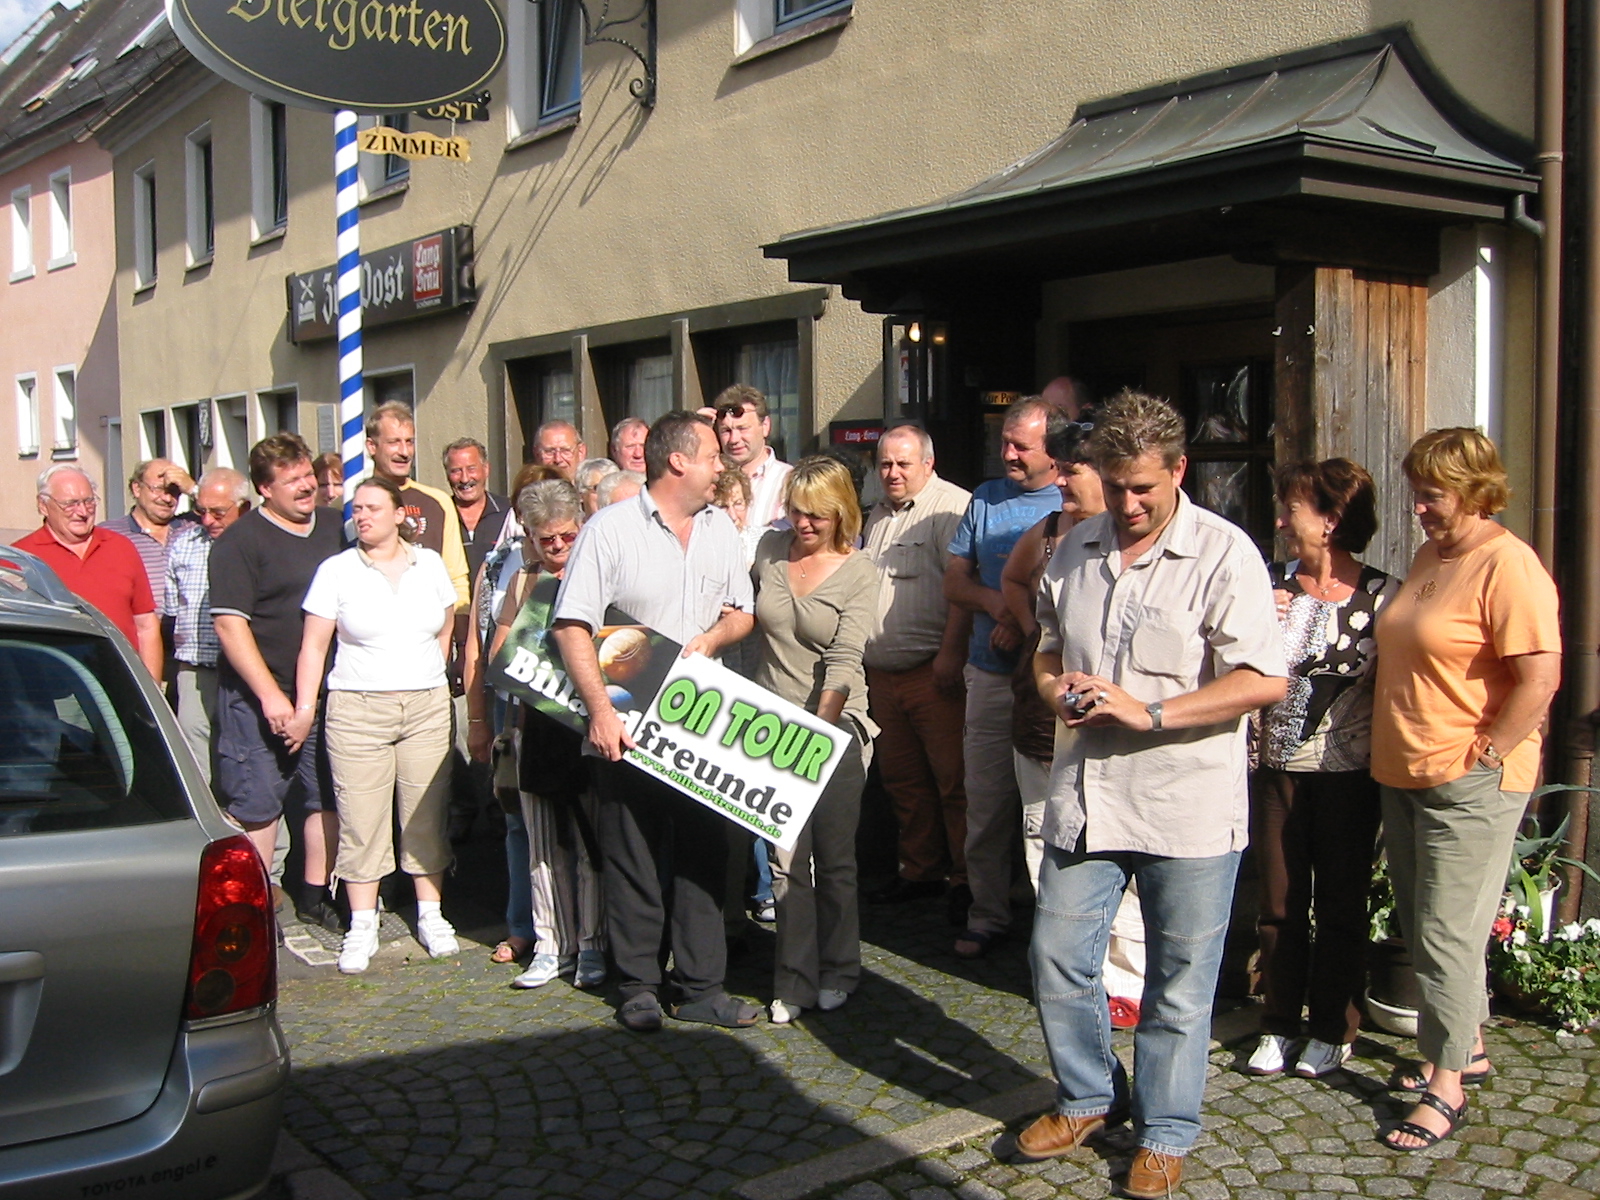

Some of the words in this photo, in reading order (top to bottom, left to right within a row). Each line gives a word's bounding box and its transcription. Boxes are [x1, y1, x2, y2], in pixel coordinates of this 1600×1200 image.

[412, 101, 479, 120] OST
[365, 133, 460, 158] ZIMMER
[658, 678, 722, 735] ON
[721, 701, 833, 782] TOUR
[81, 1175, 147, 1198] TOYOTA
